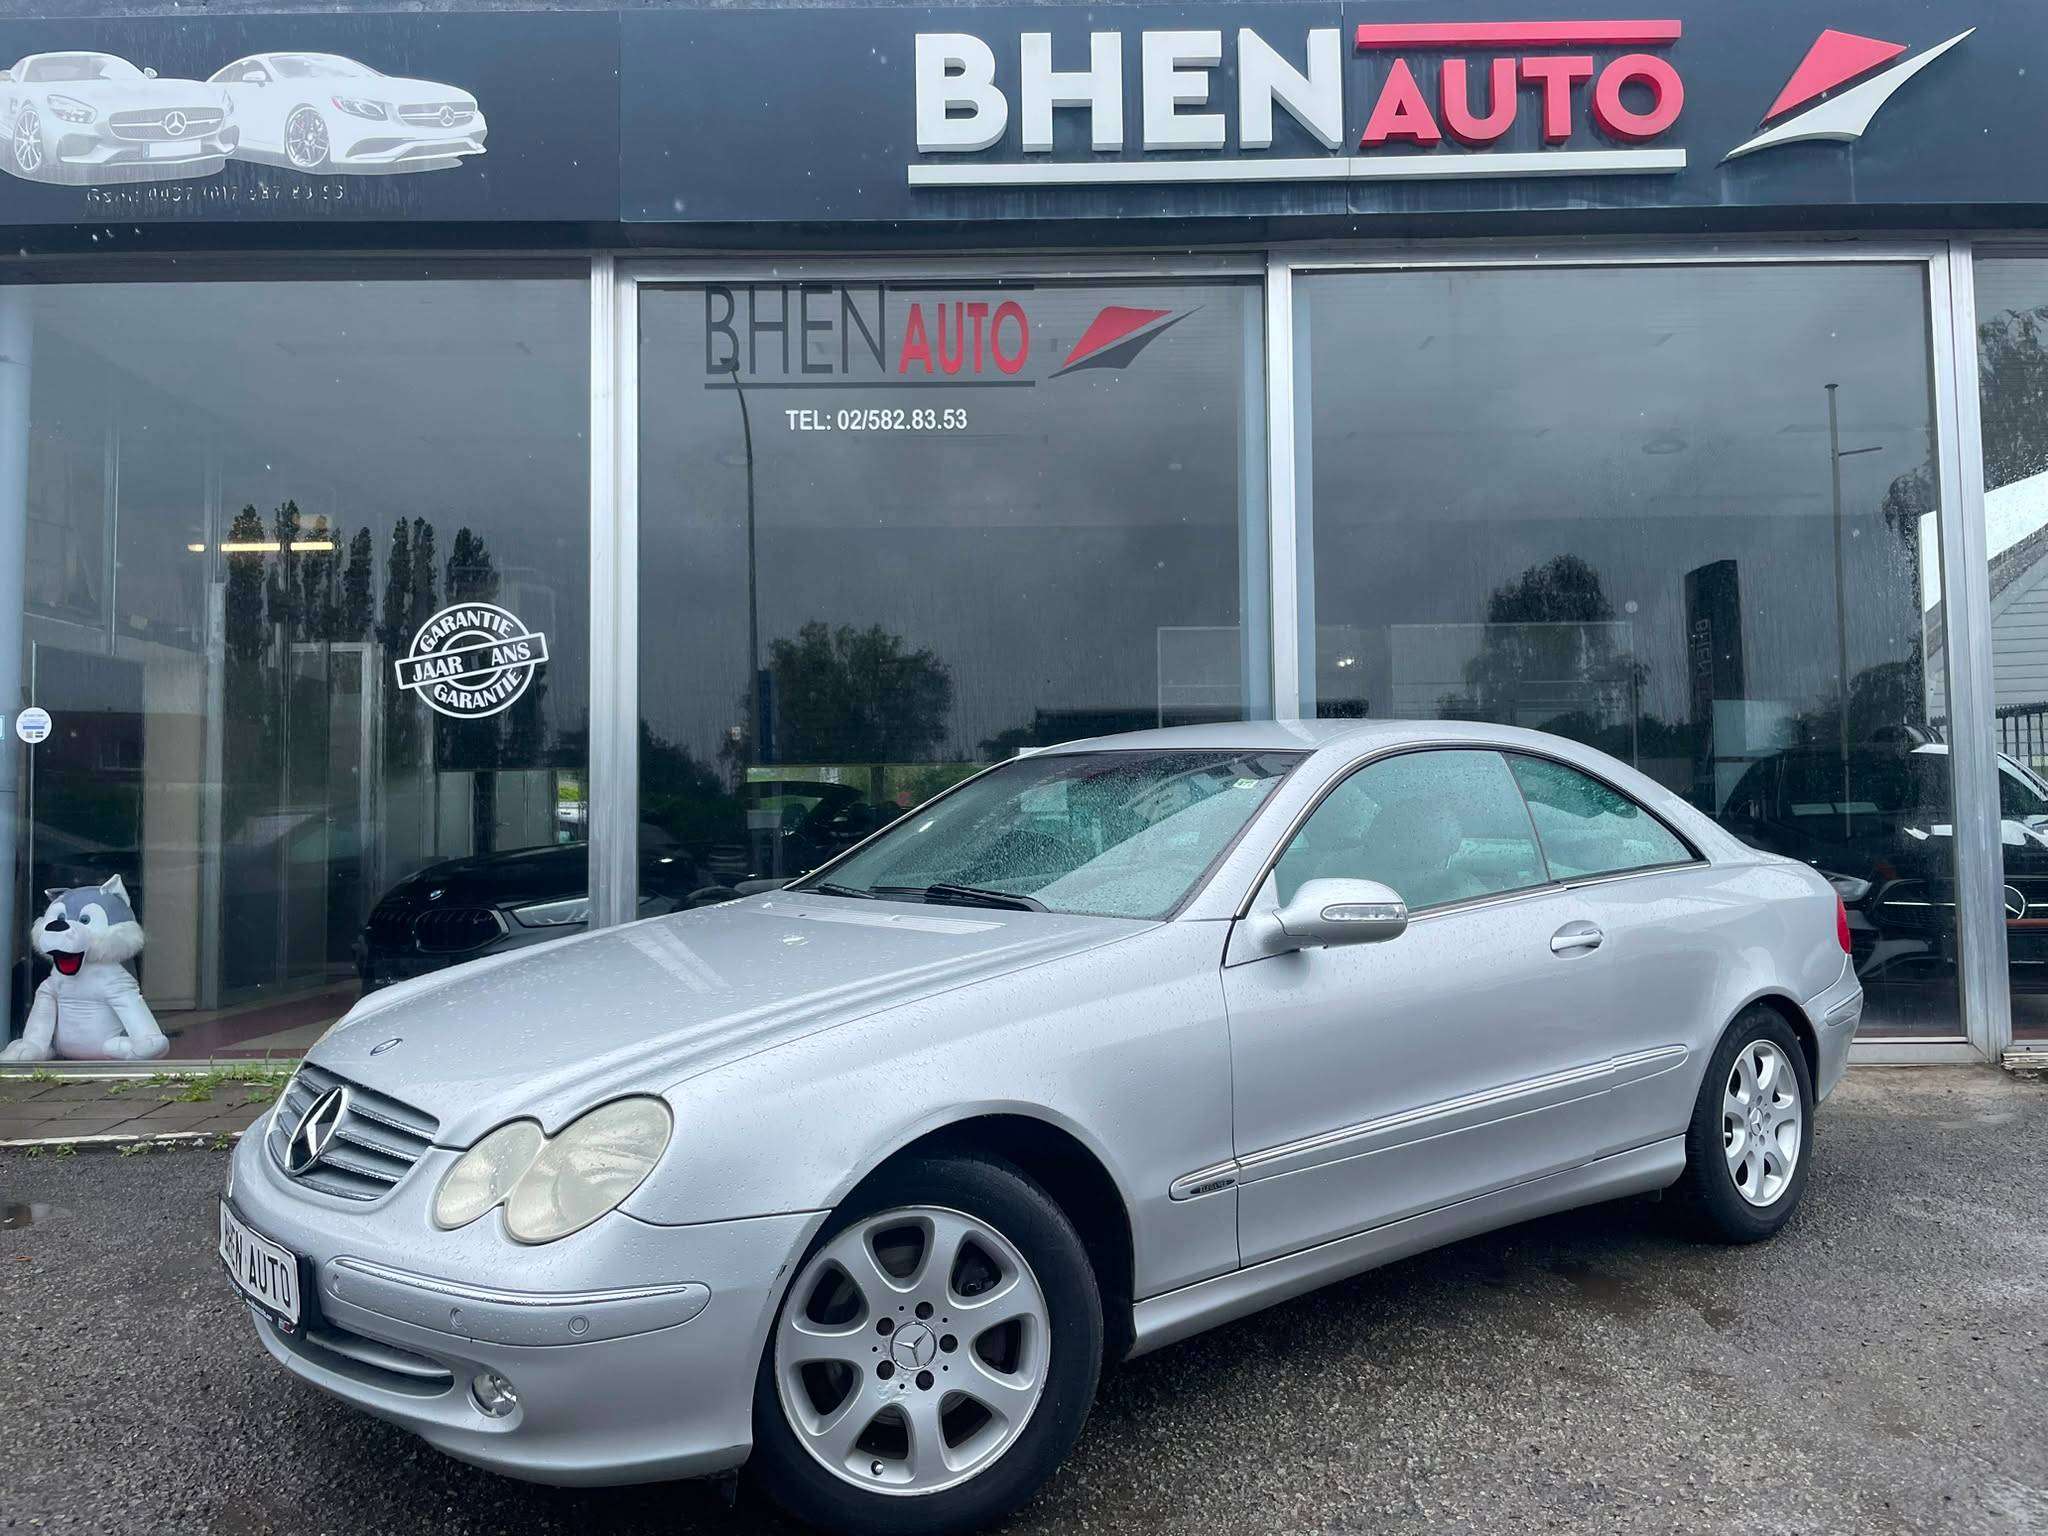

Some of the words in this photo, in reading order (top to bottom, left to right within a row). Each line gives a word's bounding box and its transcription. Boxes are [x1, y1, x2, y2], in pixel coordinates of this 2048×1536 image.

[915, 28, 1343, 153] BHEN
[1359, 53, 1685, 148] AUTO
[705, 284, 887, 375] BHEN
[898, 301, 1029, 375] AUTO
[785, 410, 832, 431] TEL:
[837, 408, 968, 431] 02/582.83.53
[419, 610, 514, 652] GARANTIE
[413, 655, 464, 682] JAAR
[490, 642, 531, 667] ANS
[433, 667, 524, 709] GARANTIE
[248, 1242, 292, 1309] AUTO
